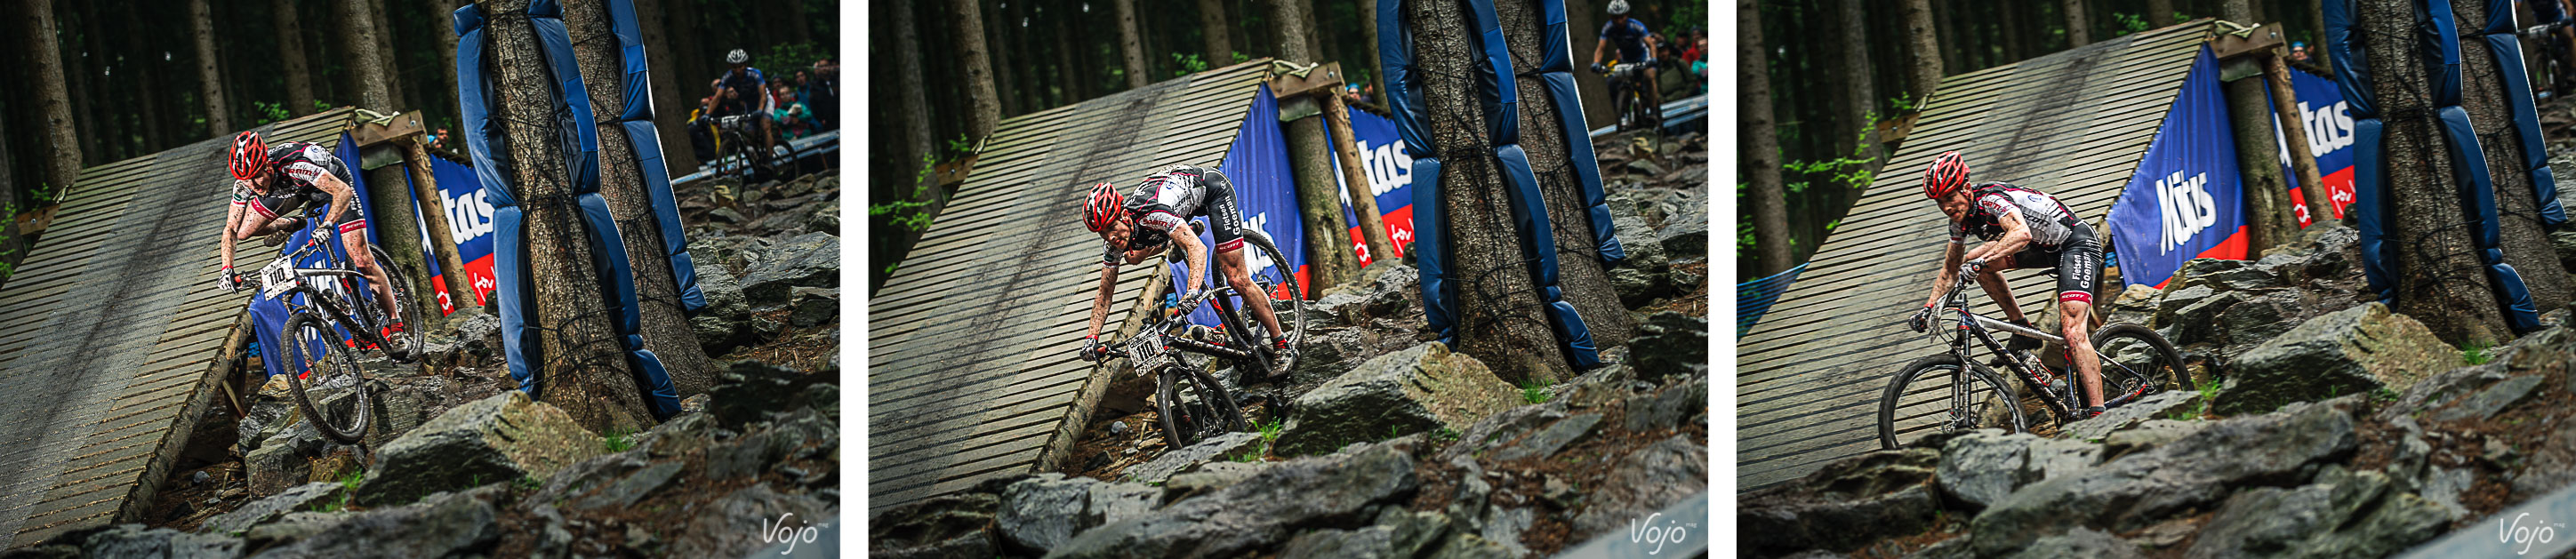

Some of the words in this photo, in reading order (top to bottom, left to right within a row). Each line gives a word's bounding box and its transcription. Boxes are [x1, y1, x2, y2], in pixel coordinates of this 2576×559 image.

[2275, 100, 2355, 167] tas
[1334, 139, 1413, 207] tas
[416, 188, 495, 255] tas
[1219, 204, 1232, 231] Fietsen
[1225, 195, 1241, 236] Goeman
[269, 268, 285, 286] 110
[2072, 254, 2082, 281] Fietsen
[2080, 252, 2092, 289] Goeman
[1137, 340, 1155, 362] 110
